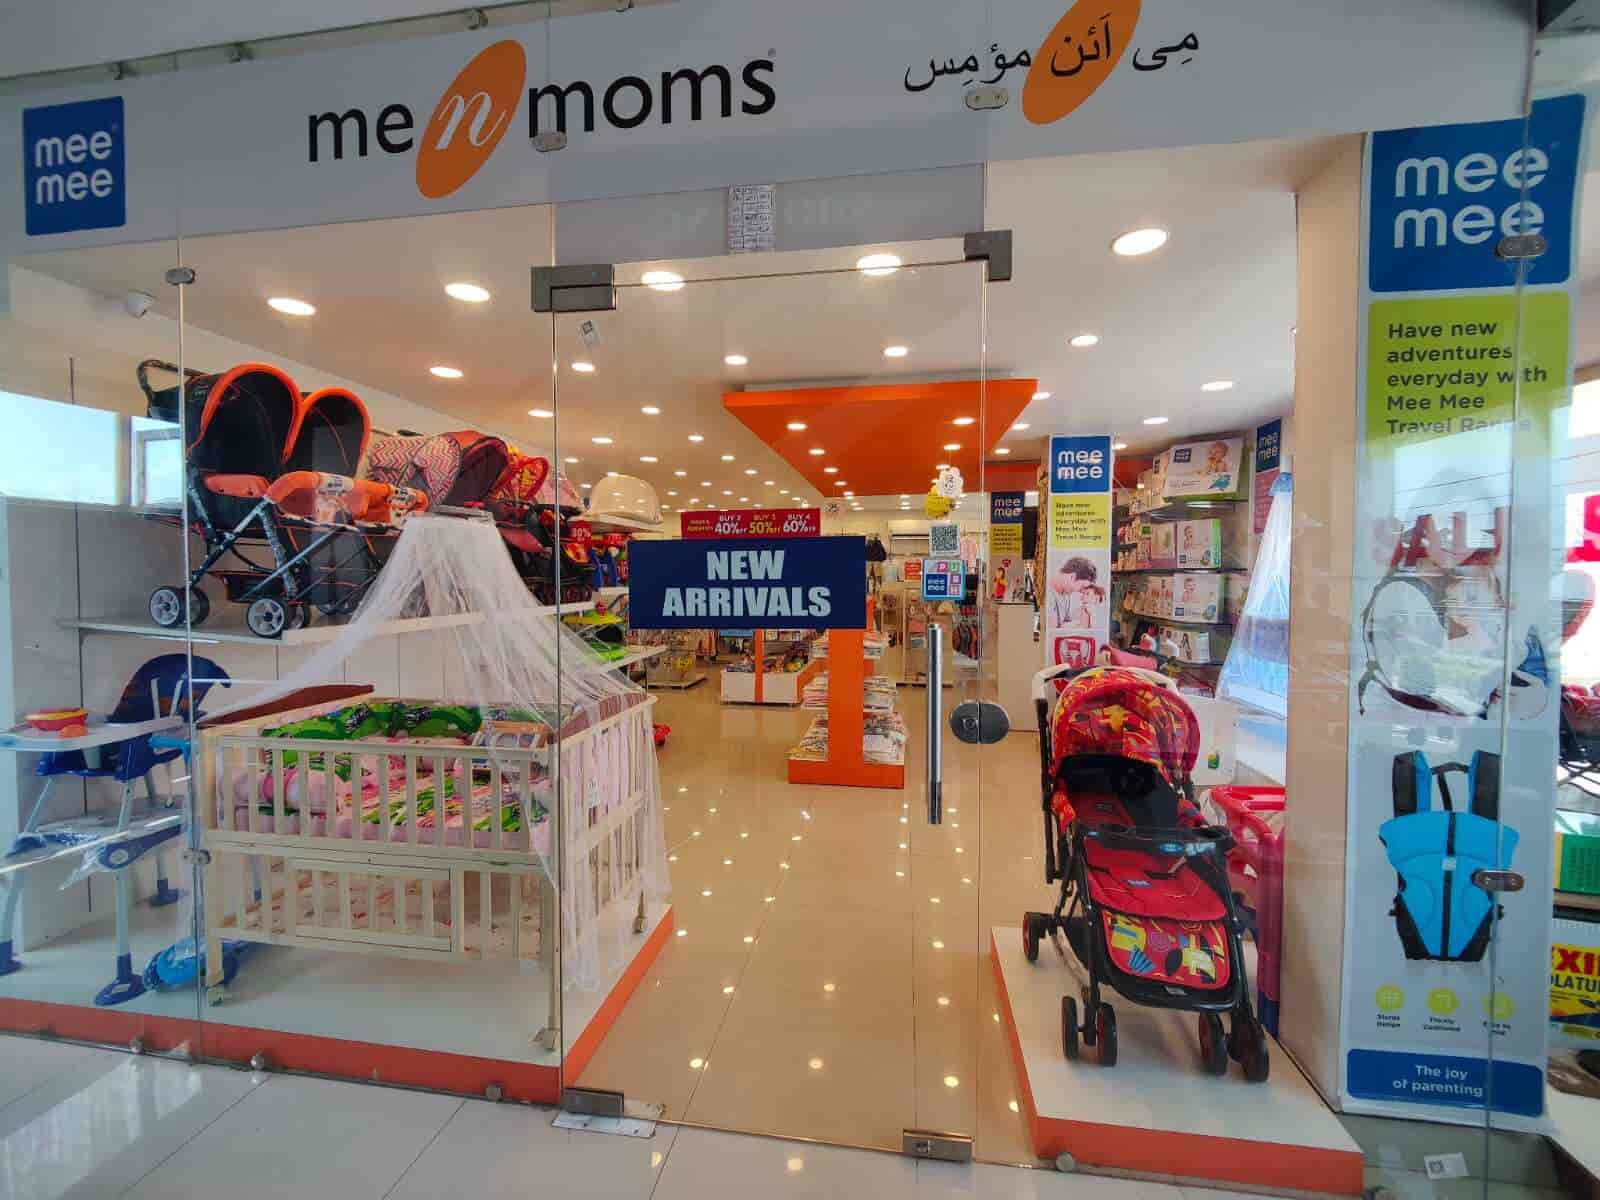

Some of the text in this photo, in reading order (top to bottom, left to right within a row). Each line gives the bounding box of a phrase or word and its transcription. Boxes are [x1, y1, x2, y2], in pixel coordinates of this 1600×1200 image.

[529, 60, 776, 138] moms
[35, 131, 112, 168] mee
[1395, 148, 1549, 197] mee
[36, 168, 113, 205] mee
[1394, 201, 1544, 249] mee
[1388, 322, 1497, 339] Have new
[1387, 345, 1513, 364] adventures
[1387, 367, 1547, 388] everyday wth
[1387, 393, 1486, 411] Mee Mee
[1386, 417, 1451, 434] Travel
[1058, 449, 1104, 465] mee
[1057, 465, 1103, 480] mee
[706, 550, 785, 580] NEW
[662, 586, 832, 616] ARRIVALS
[1415, 1065, 1468, 1081] The joy
[1392, 1079, 1483, 1098] of parenting
